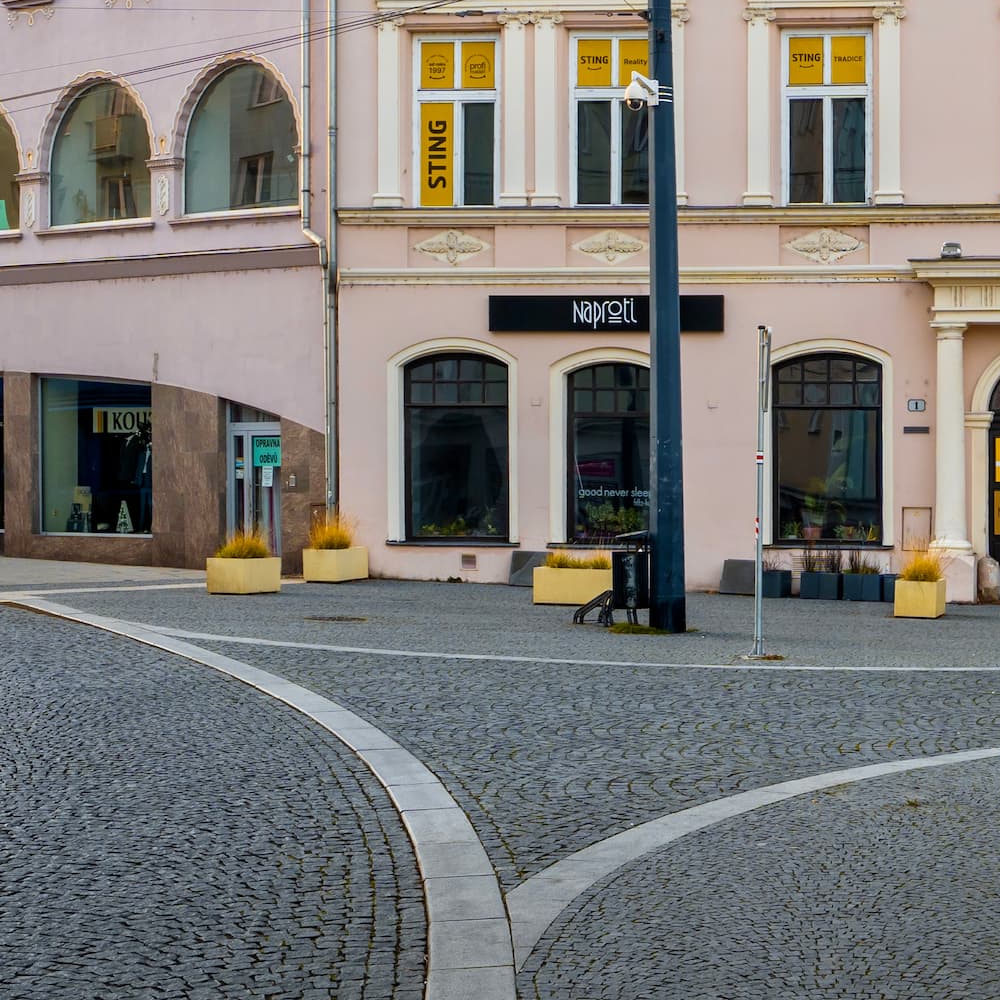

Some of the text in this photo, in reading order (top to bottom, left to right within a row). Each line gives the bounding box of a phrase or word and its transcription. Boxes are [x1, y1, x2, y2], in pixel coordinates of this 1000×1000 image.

[580, 55, 609, 64] STING
[623, 58, 647, 66] Reality
[792, 53, 821, 63] STING
[427, 120, 447, 189] STING
[573, 297, 637, 329] Naproti
[112, 411, 152, 431] KOU
[256, 439, 280, 448] OPRAVNA
[578, 485, 650, 498] good never slee
